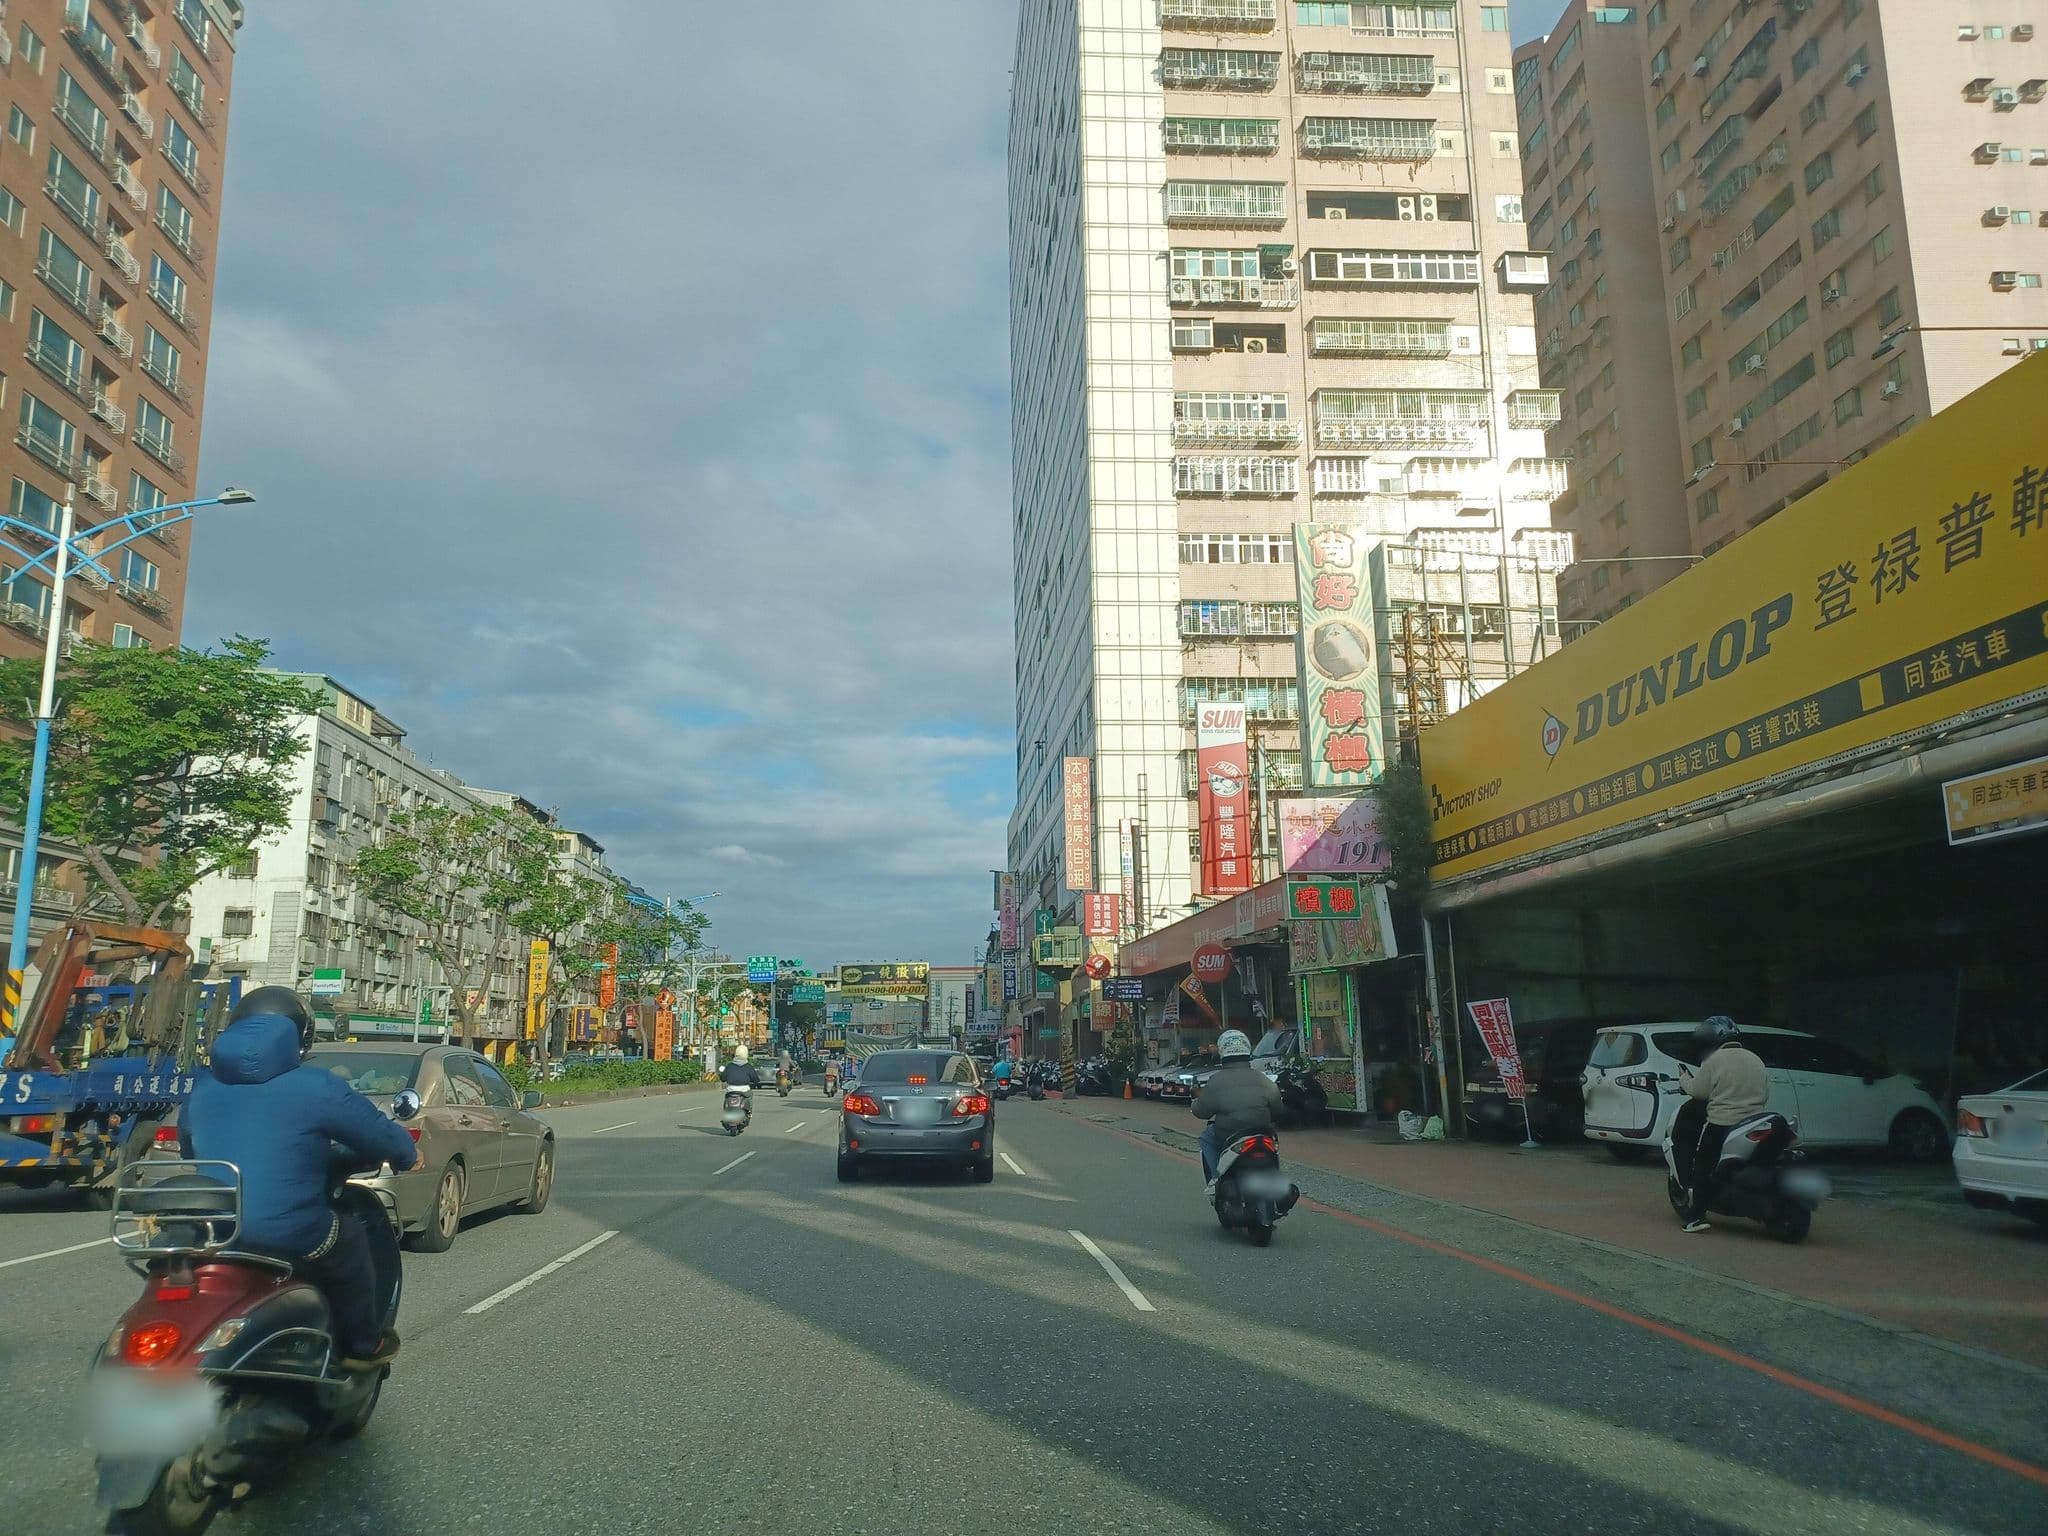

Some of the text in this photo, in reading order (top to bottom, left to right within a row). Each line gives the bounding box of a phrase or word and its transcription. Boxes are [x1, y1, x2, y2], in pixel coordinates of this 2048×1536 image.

[1574, 593, 1793, 746] DUNLOP
[1202, 710, 1243, 728] SUM
[1588, 772, 1637, 808] 輪胎鋁圈
[1660, 742, 1719, 781] 四輪定位
[1747, 700, 1823, 750] 音響改裝
[1904, 628, 2012, 694] 同益汽車
[1219, 763, 1239, 778] SUM
[1442, 778, 1502, 818] VICTORY SHOP
[1071, 760, 1085, 887] 本棟套房自租
[1287, 805, 1345, 838] 如意
[1335, 841, 1382, 866] 191
[1295, 886, 1356, 914] 檳榔
[1198, 954, 1225, 968] SUM
